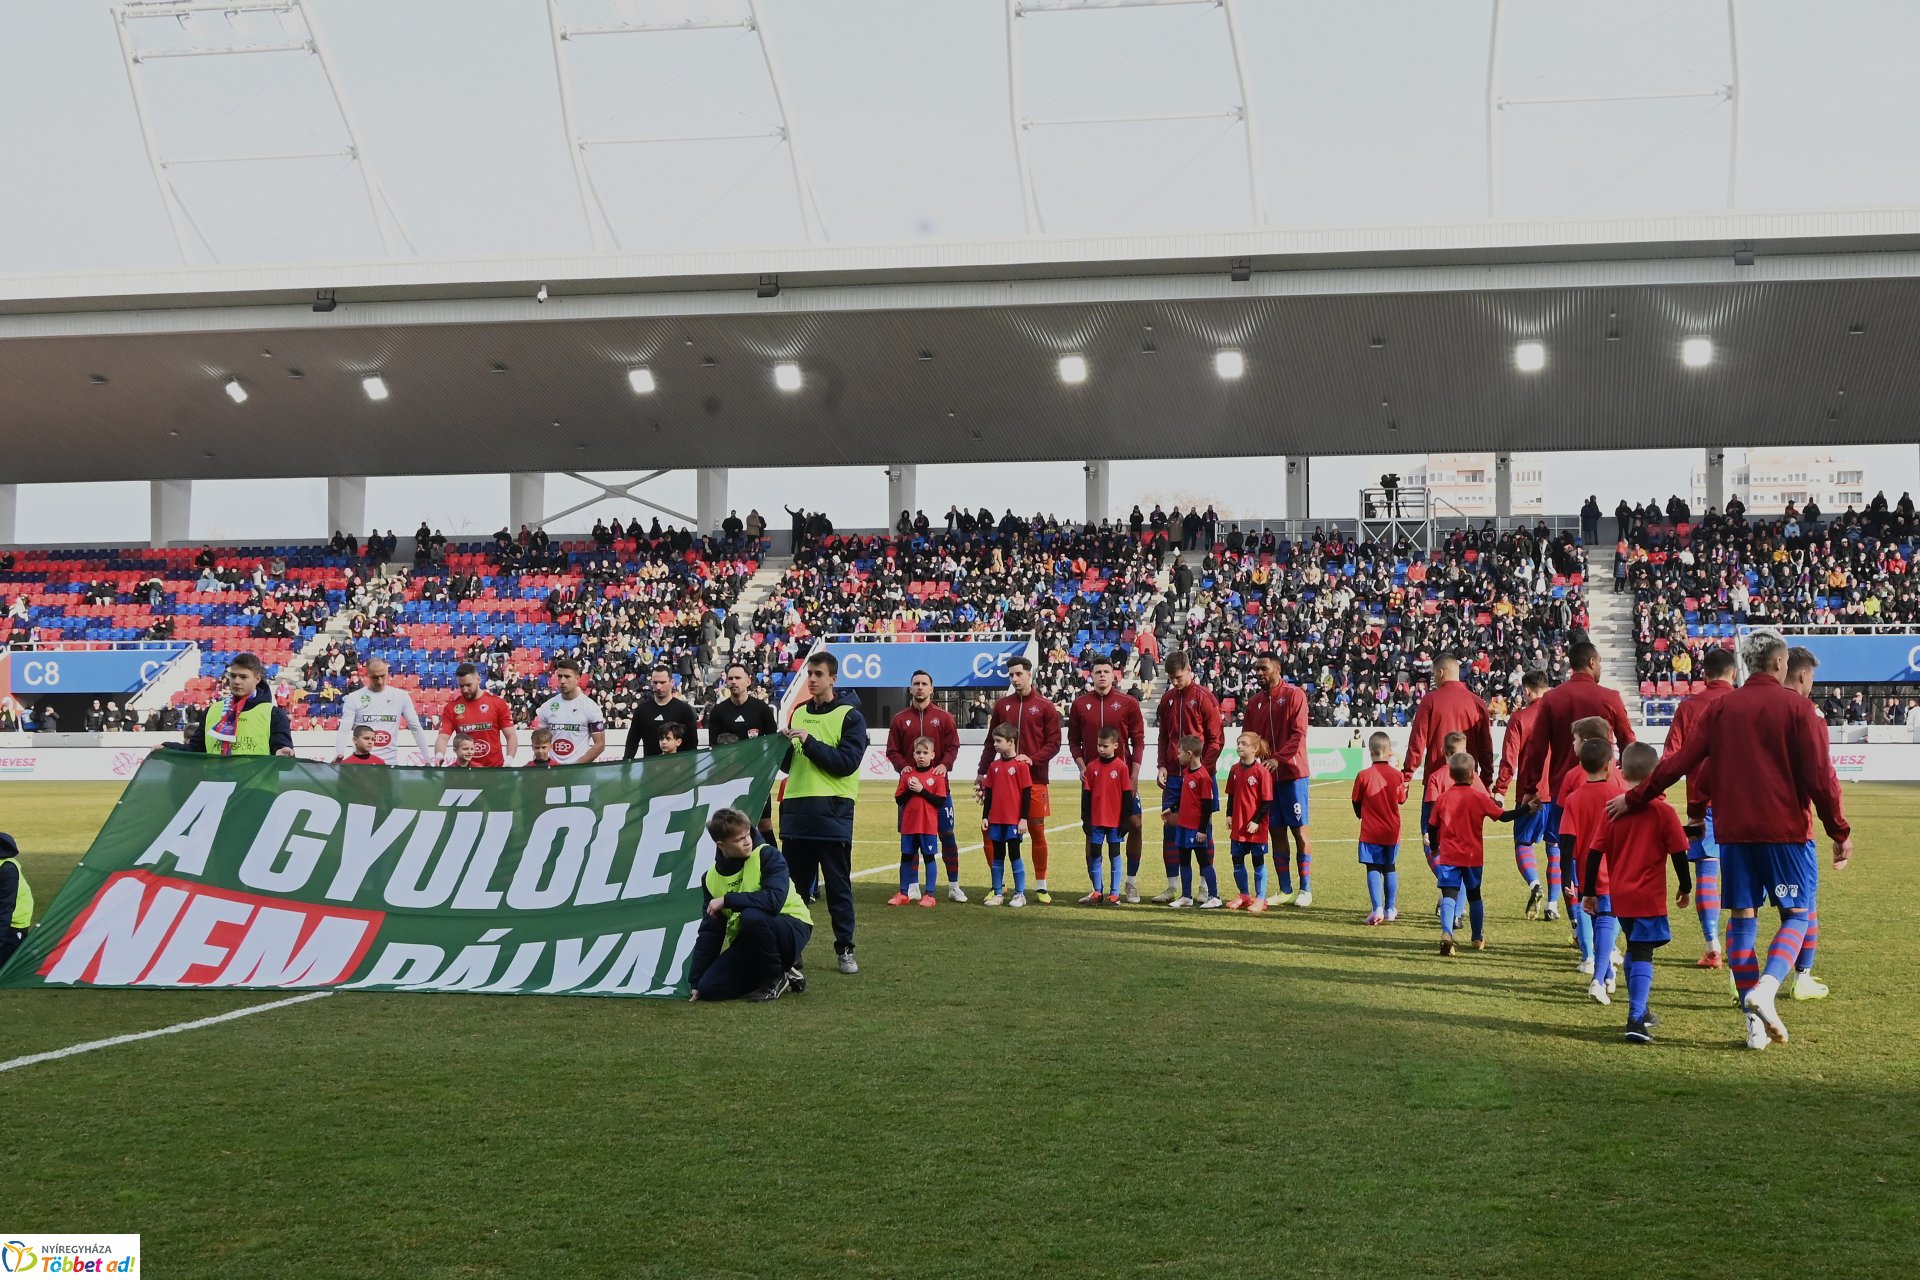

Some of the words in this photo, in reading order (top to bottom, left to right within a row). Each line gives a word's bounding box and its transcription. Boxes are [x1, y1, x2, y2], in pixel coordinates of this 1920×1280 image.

[24, 661, 60, 686] C8
[842, 653, 882, 679] C6
[972, 652, 1012, 678] C5
[1293, 802, 1302, 815] 8
[134, 781, 237, 876] A
[44, 876, 370, 987] NEM
